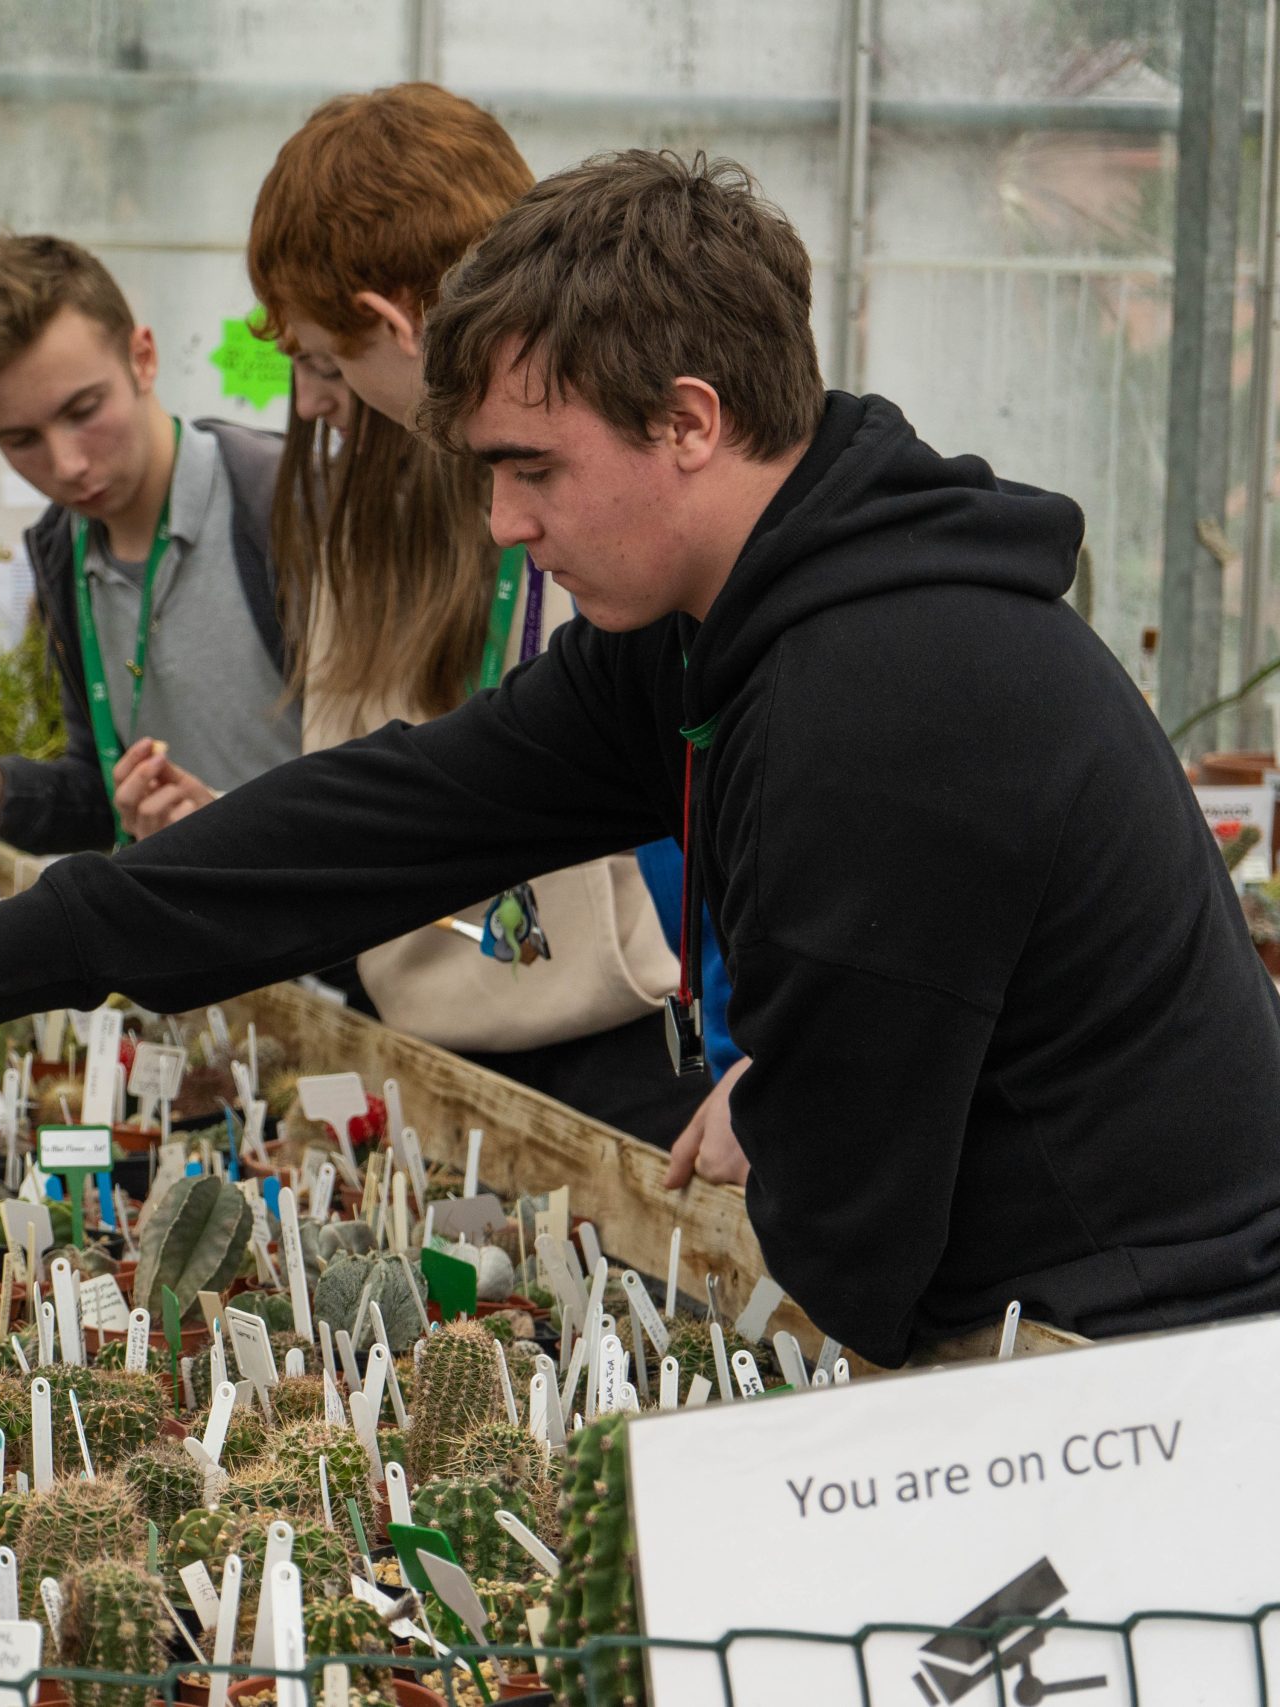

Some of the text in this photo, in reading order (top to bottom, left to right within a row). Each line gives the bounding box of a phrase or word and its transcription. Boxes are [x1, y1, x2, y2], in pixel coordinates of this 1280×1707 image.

[786, 1420, 1183, 1518] You are on CCTV
